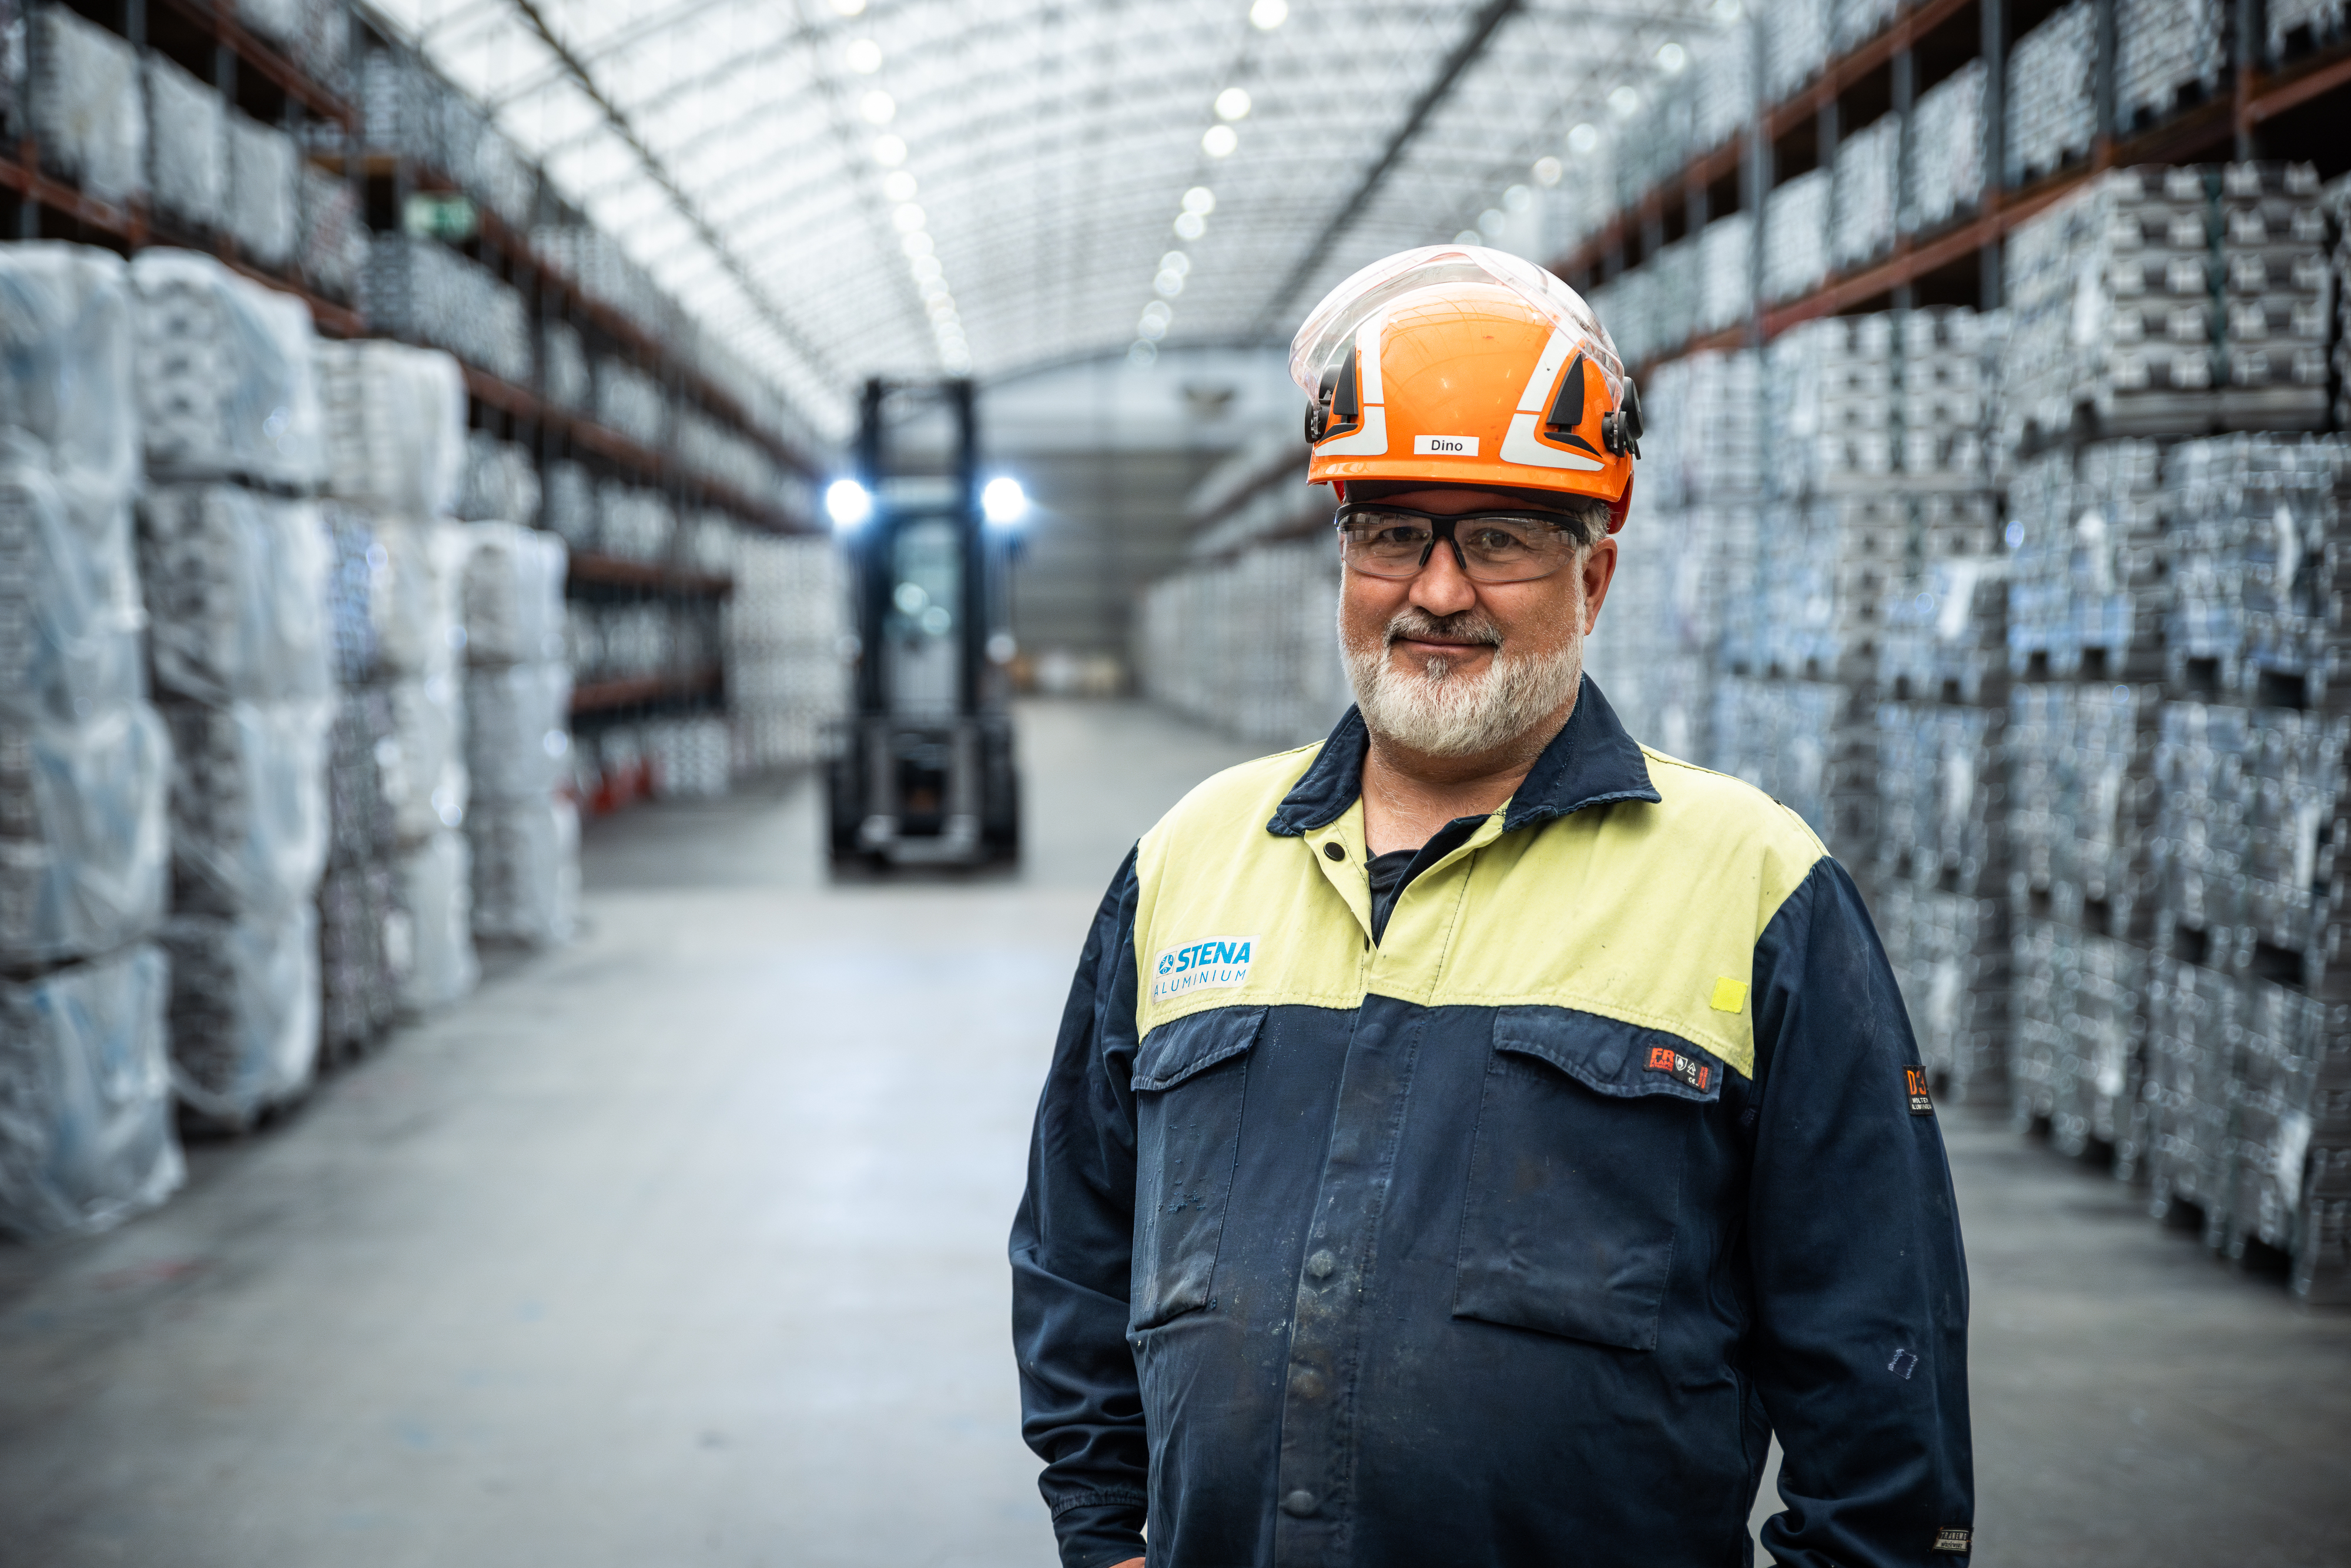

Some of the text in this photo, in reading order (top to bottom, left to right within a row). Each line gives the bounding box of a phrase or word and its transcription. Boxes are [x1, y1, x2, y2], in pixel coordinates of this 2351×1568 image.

[1431, 440, 1463, 451] Dino
[1176, 942, 1251, 973] STENA
[1154, 969, 1247, 997] ALUMINIUM
[1651, 1047, 1675, 1063] FR
[1907, 1070, 1927, 1095] D3
